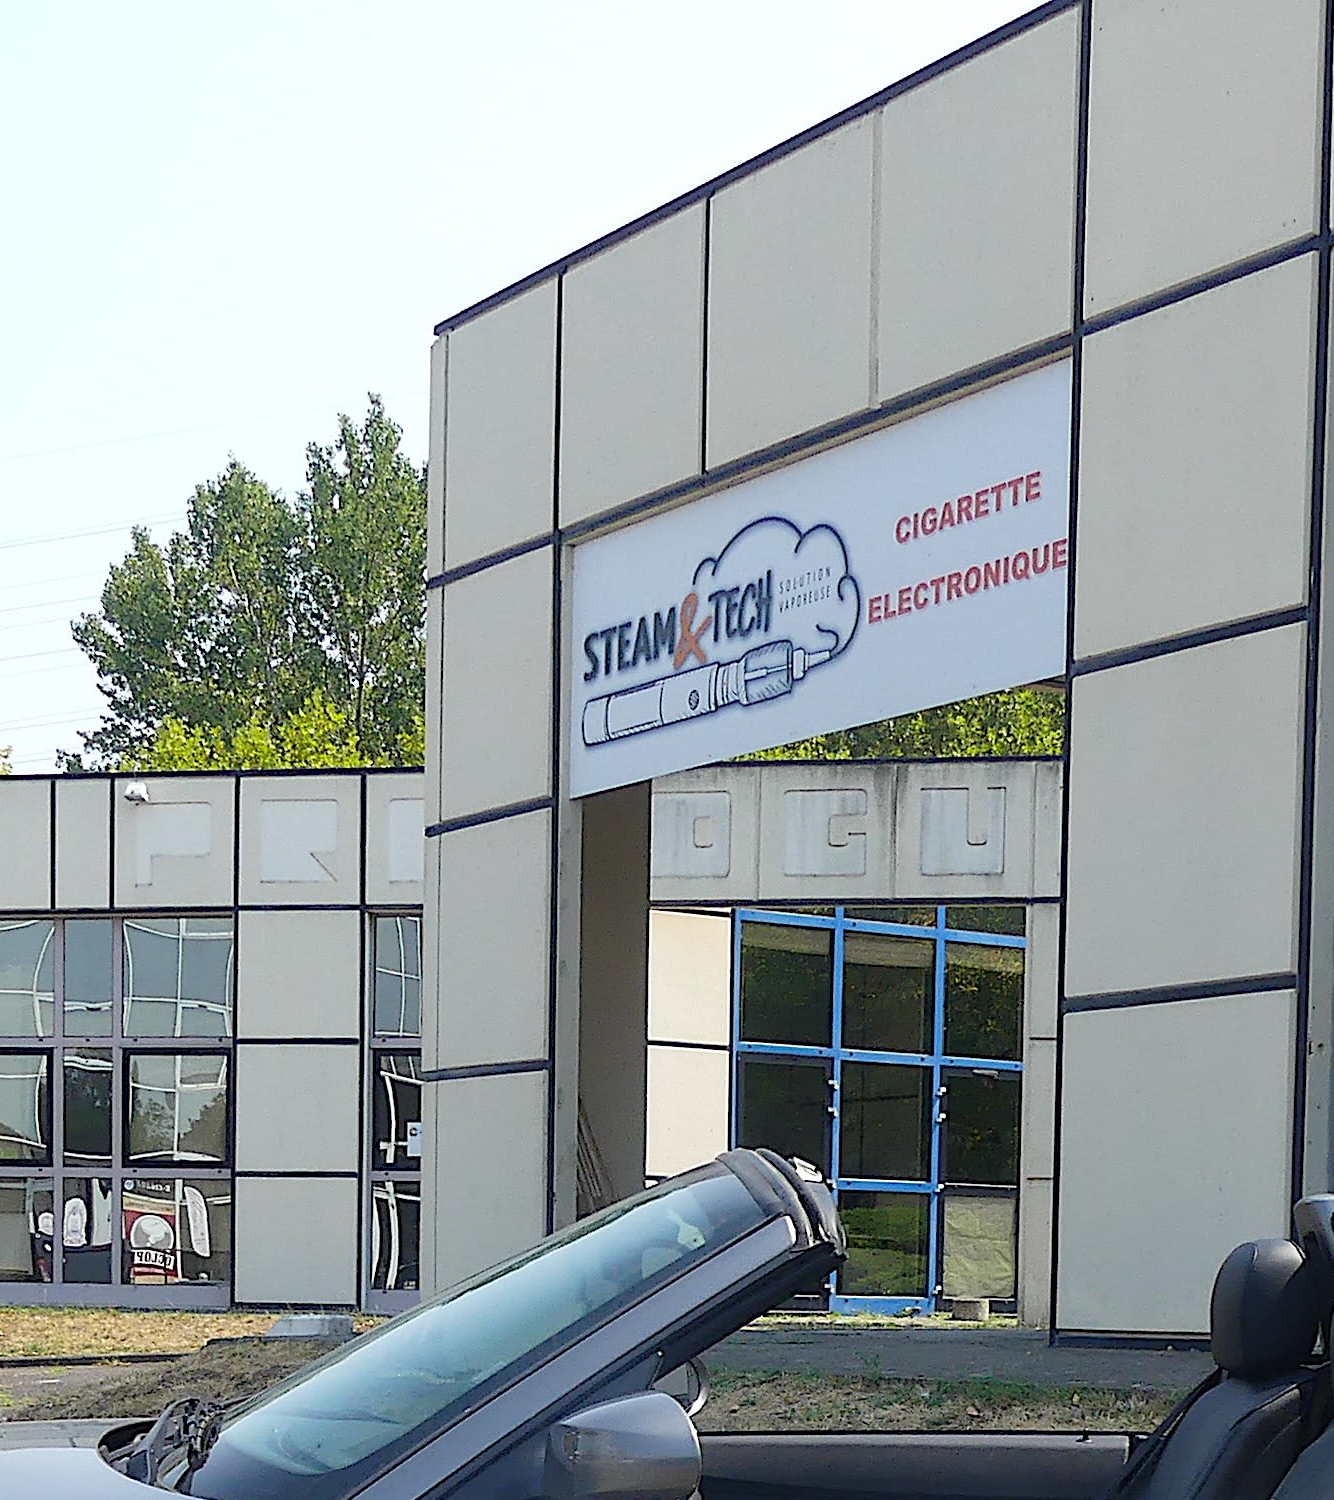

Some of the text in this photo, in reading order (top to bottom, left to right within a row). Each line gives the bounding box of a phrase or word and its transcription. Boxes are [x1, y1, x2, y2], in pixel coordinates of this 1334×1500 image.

[895, 471, 1041, 545] CIGARETTE
[779, 567, 831, 595] SOLUTION
[779, 585, 830, 613] VAPOREUSE
[868, 538, 1068, 625] ELECTRONIQUE
